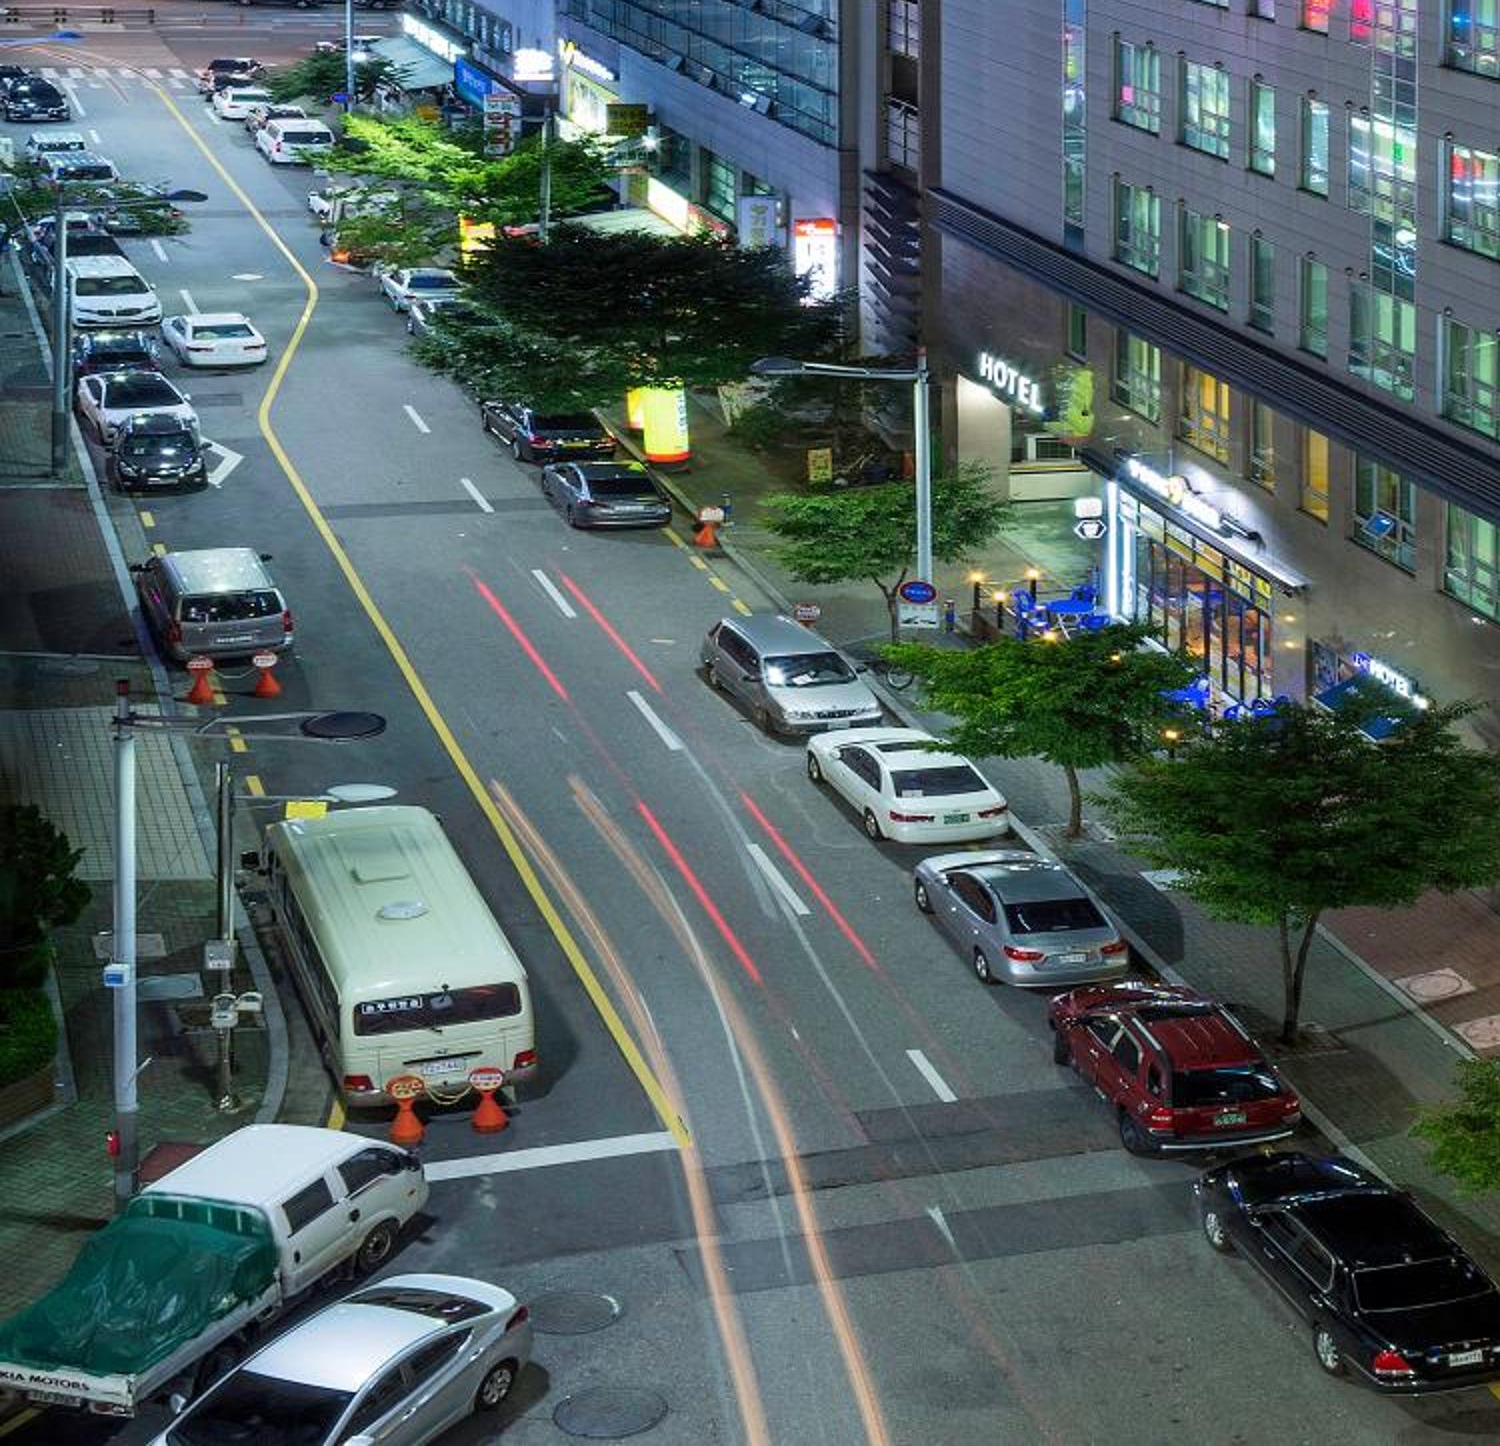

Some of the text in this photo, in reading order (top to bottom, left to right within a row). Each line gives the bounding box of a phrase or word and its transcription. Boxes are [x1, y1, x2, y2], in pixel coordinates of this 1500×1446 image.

[980, 351, 1044, 413] HOTEL
[0, 1371, 90, 1391] KIA MOTORS
